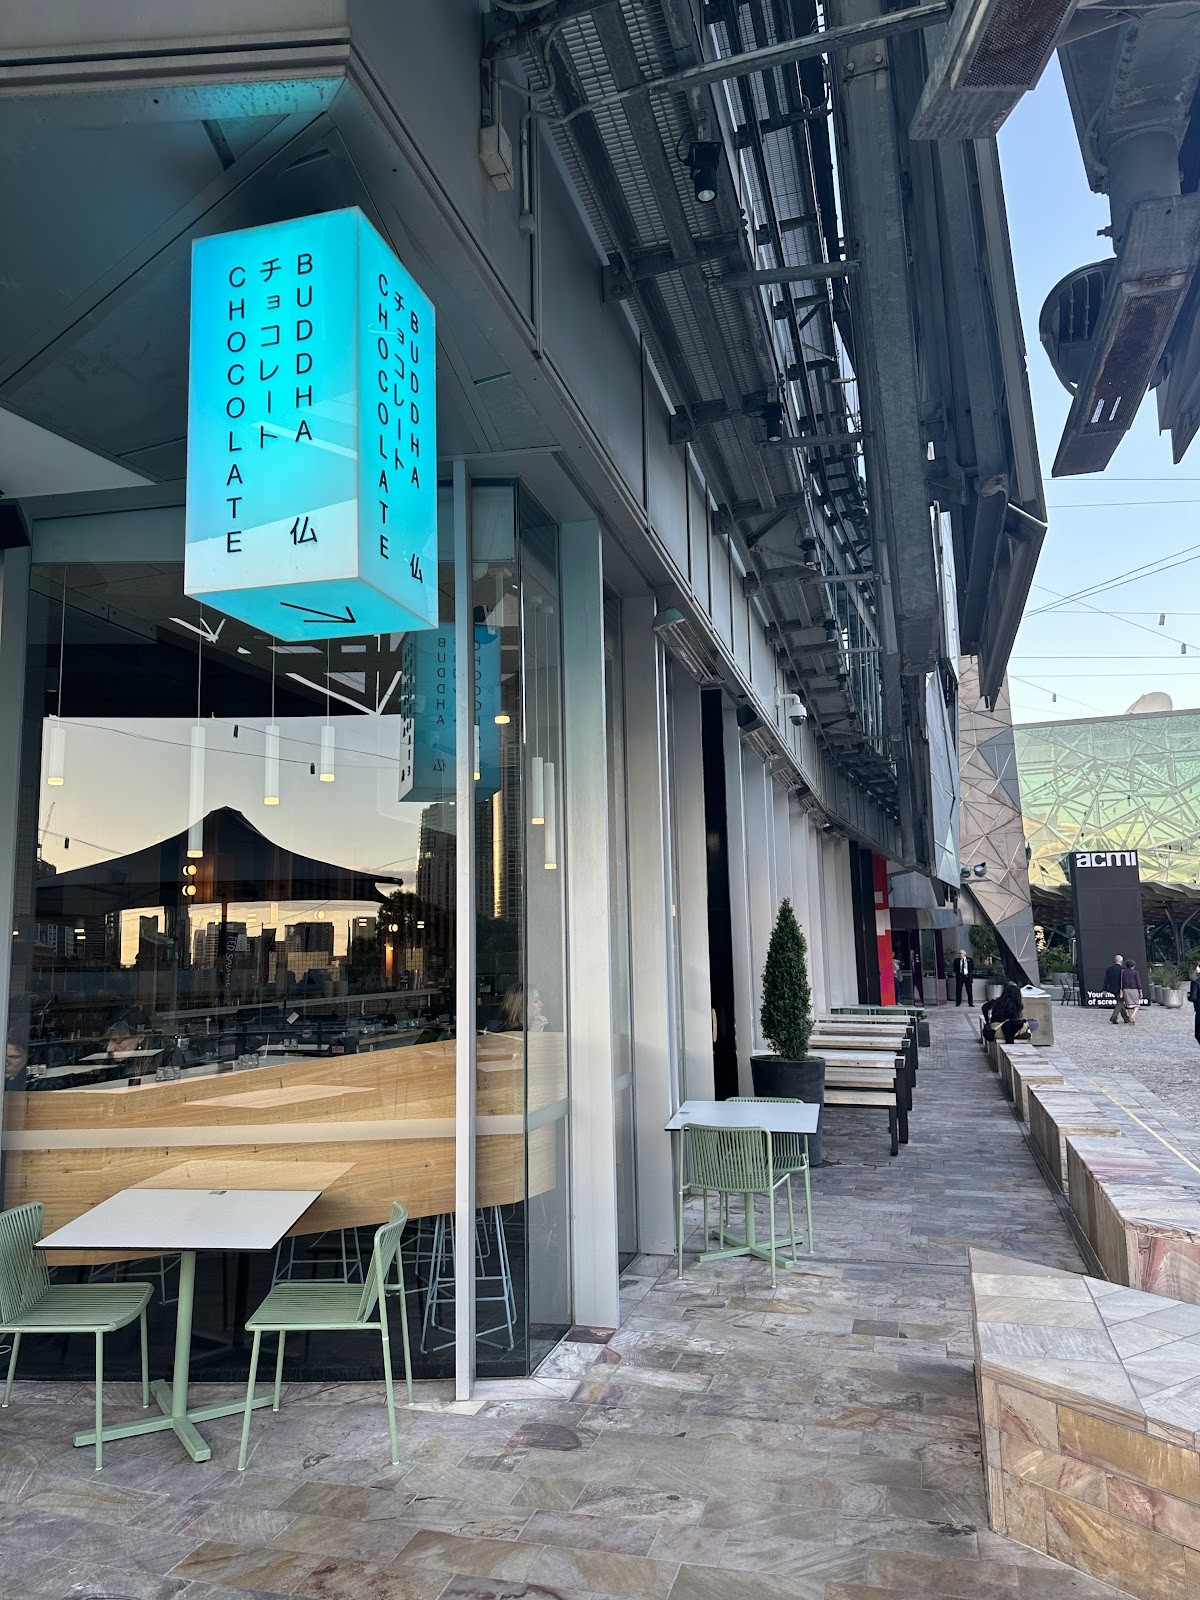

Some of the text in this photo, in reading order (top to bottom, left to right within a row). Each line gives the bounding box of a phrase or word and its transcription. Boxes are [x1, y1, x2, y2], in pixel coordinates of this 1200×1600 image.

[226, 265, 247, 554] CHOCOLATE
[259, 257, 283, 450] チョコレート
[295, 252, 314, 444] BUDDHA
[378, 273, 390, 560] CHOCOLATE
[392, 293, 406, 471] チョコレート
[409, 310, 420, 490] BUDDHA
[289, 515, 319, 546] 仏
[409, 552, 424, 585] 仏
[1076, 851, 1136, 868] acmi
